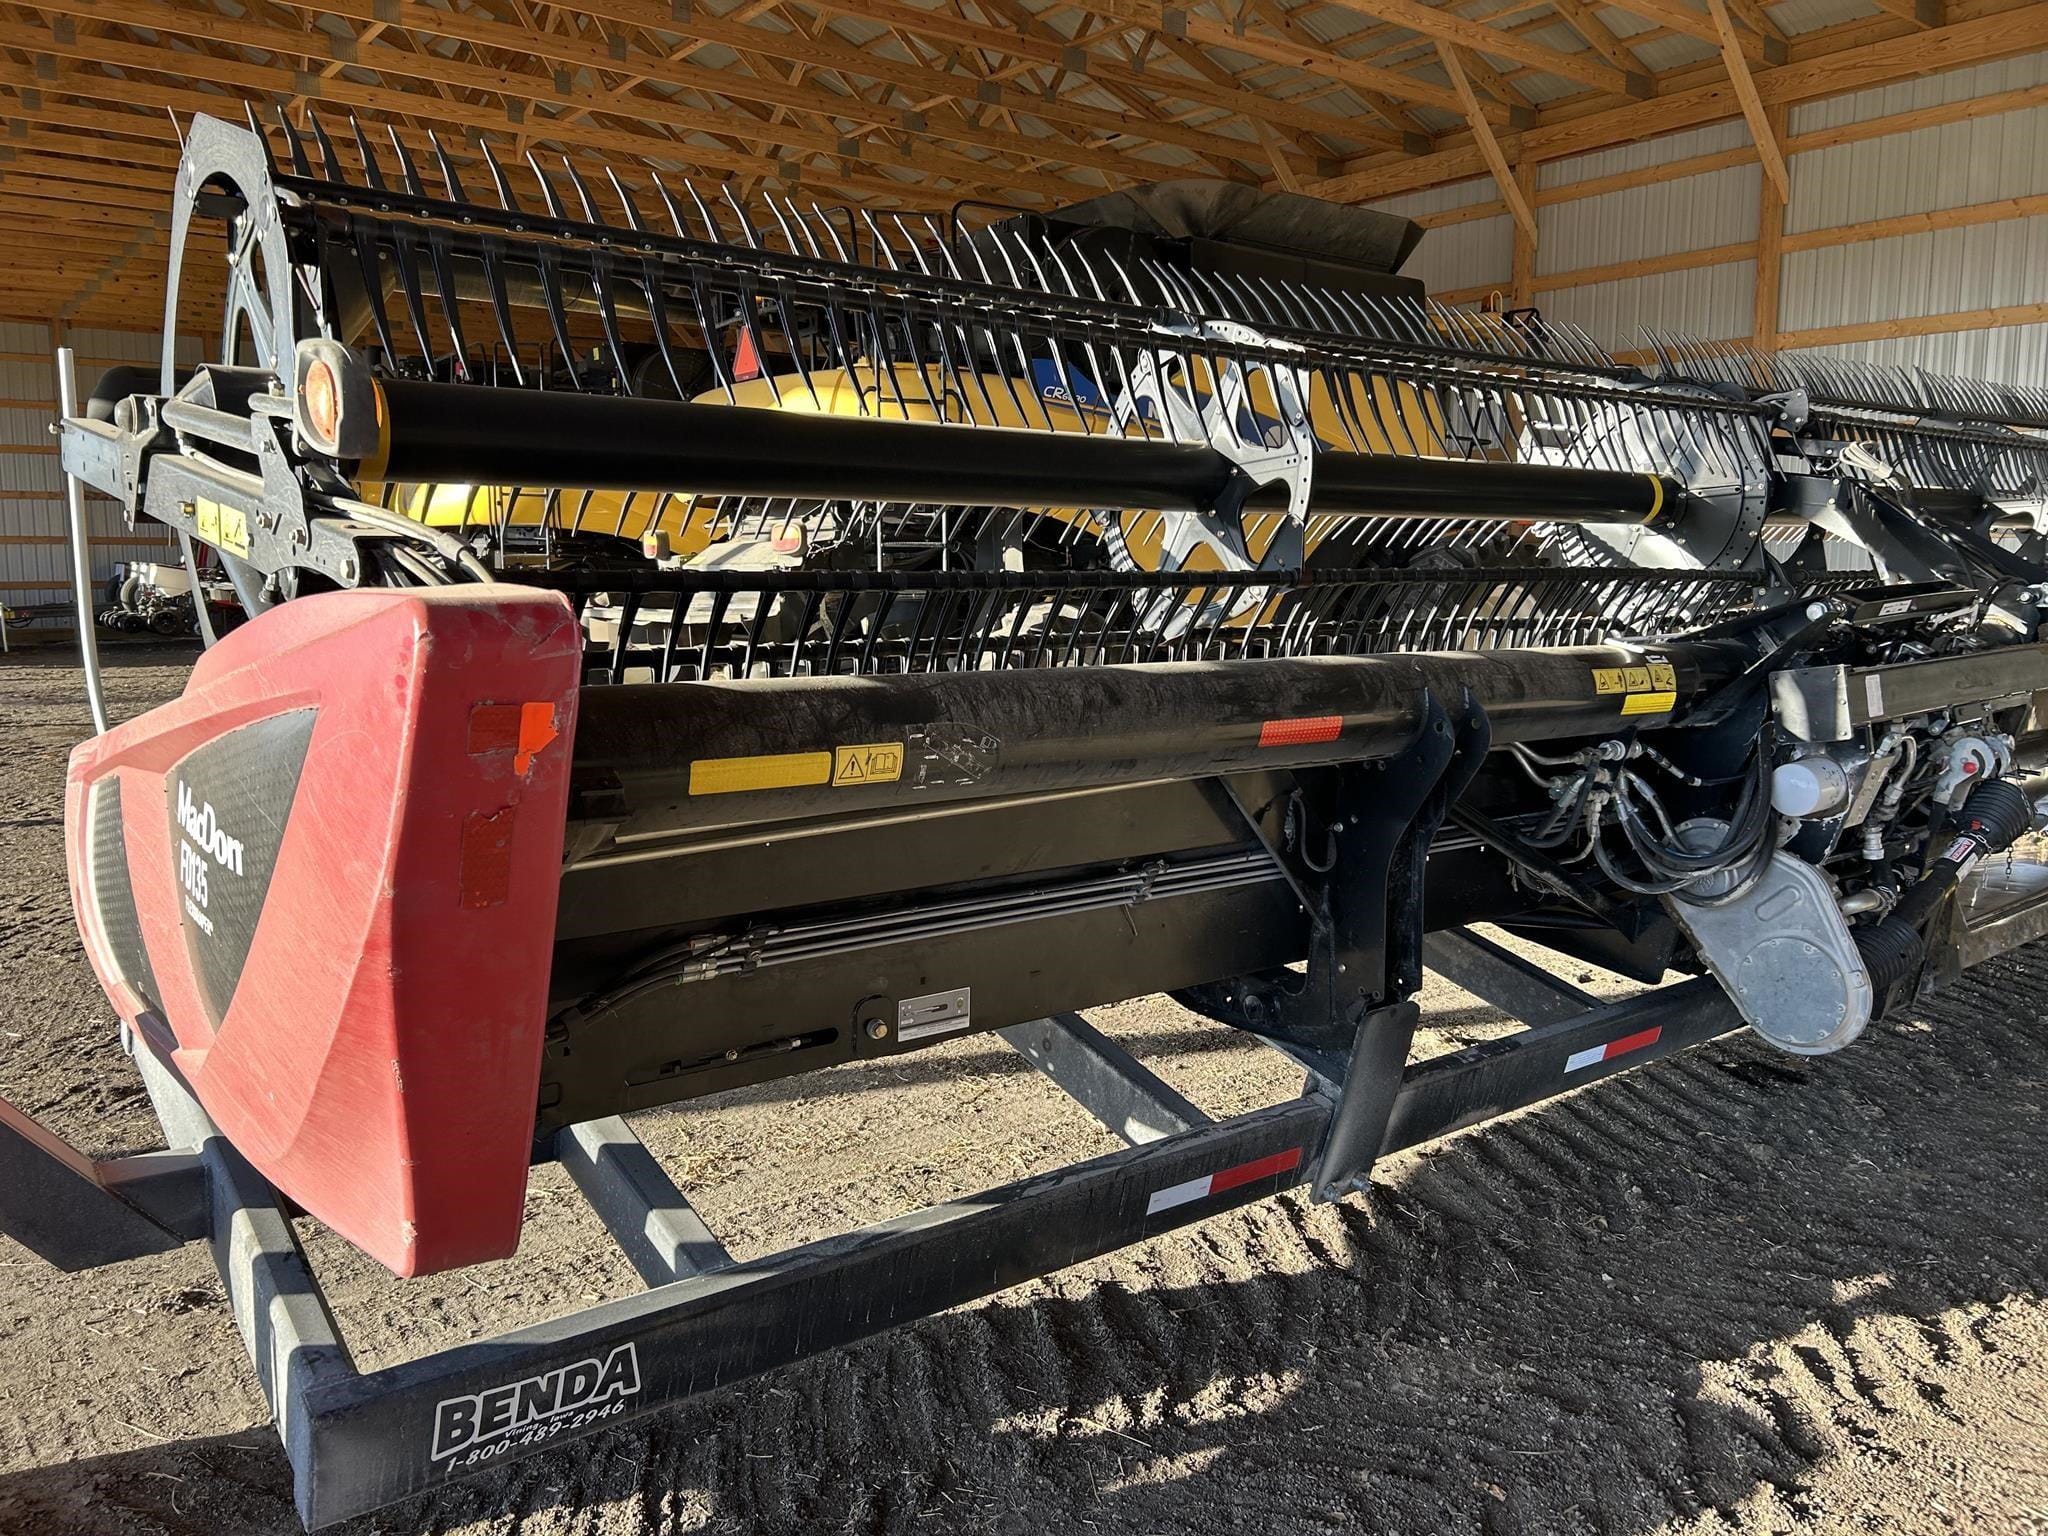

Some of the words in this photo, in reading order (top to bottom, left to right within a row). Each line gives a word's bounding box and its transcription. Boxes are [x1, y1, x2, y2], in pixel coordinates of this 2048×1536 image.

[177, 780, 243, 877] MacDon
[180, 839, 208, 908] FD135
[431, 1342, 641, 1462] BENDA
[446, 1398, 626, 1473] 1-800-489-2946
